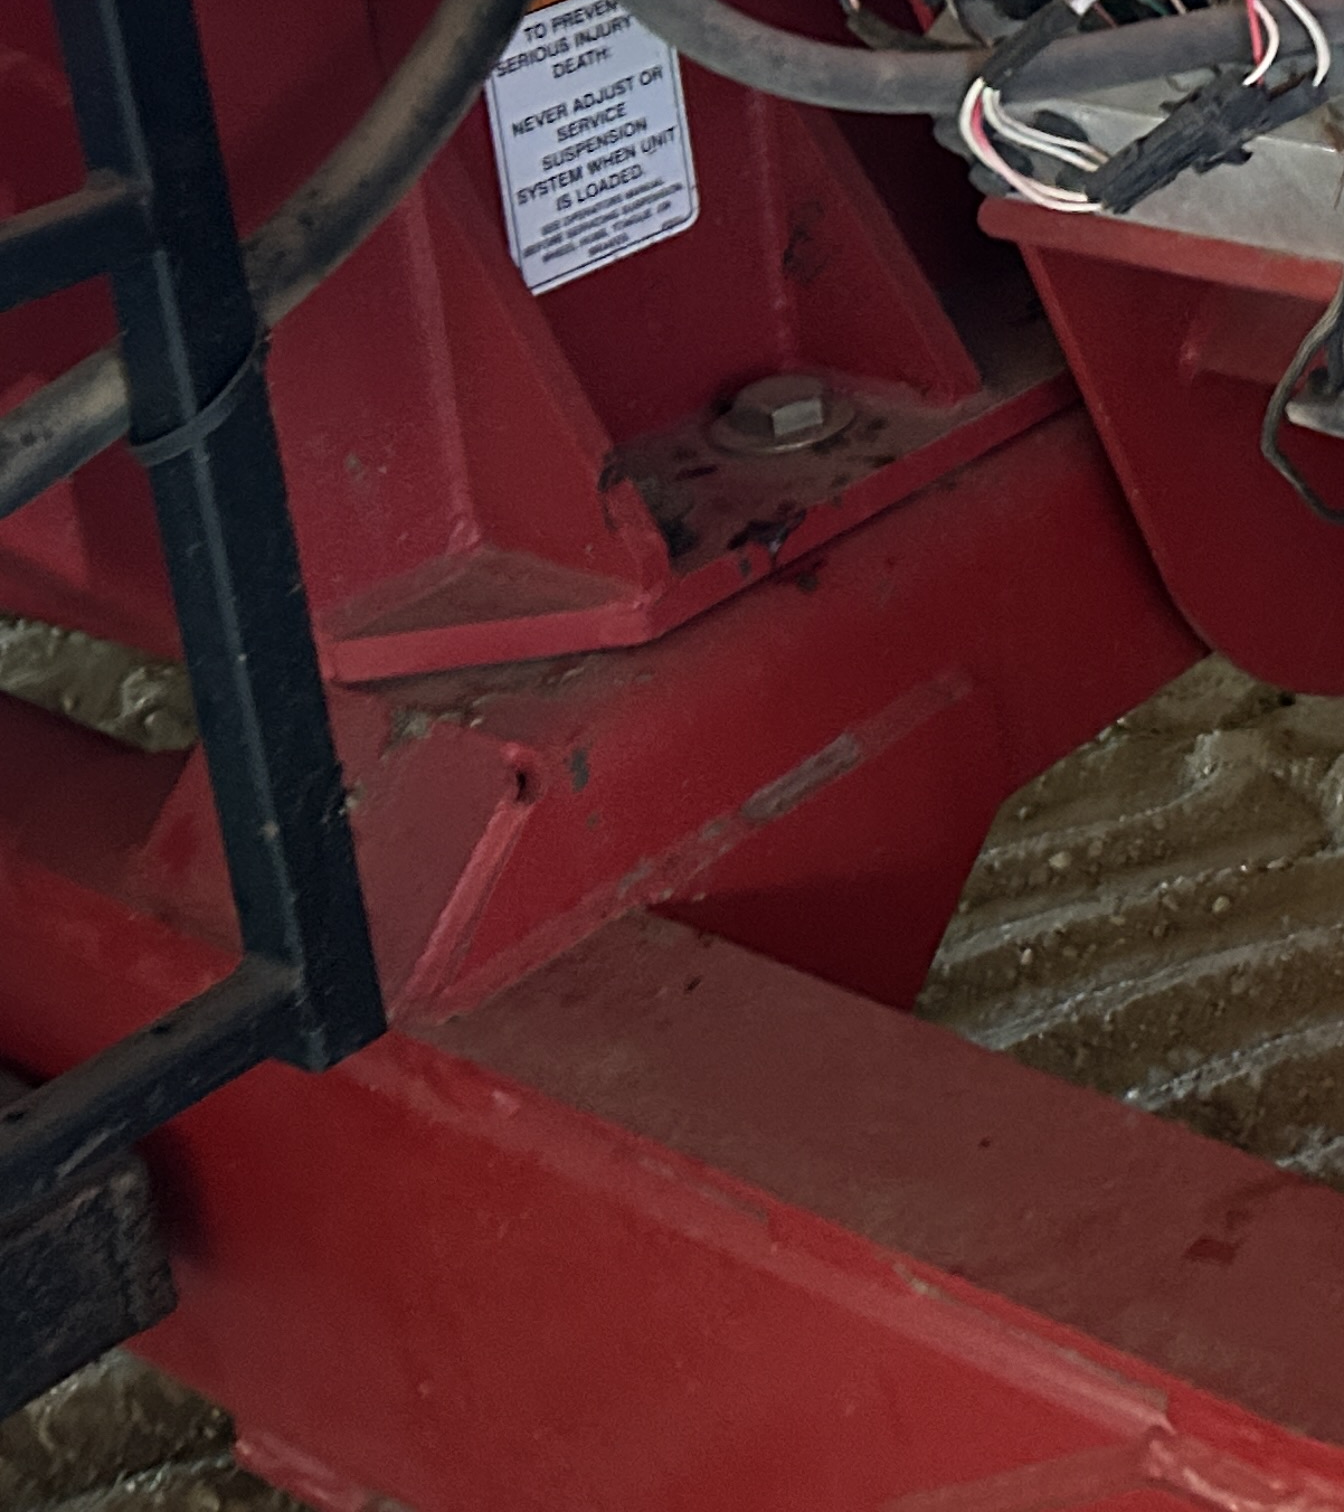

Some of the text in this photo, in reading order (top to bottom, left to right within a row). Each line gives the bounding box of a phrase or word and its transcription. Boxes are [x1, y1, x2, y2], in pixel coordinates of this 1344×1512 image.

[494, 15, 632, 77] SERIOUS INJURY
[523, 23, 547, 42] TO
[511, 66, 664, 136] NEVER ADJUST OR
[556, 102, 628, 143] SERVICE
[515, 125, 678, 205] SYSTEM WHEN UNIT
[541, 117, 647, 171] SUSPENSION
[556, 193, 573, 211] IS
